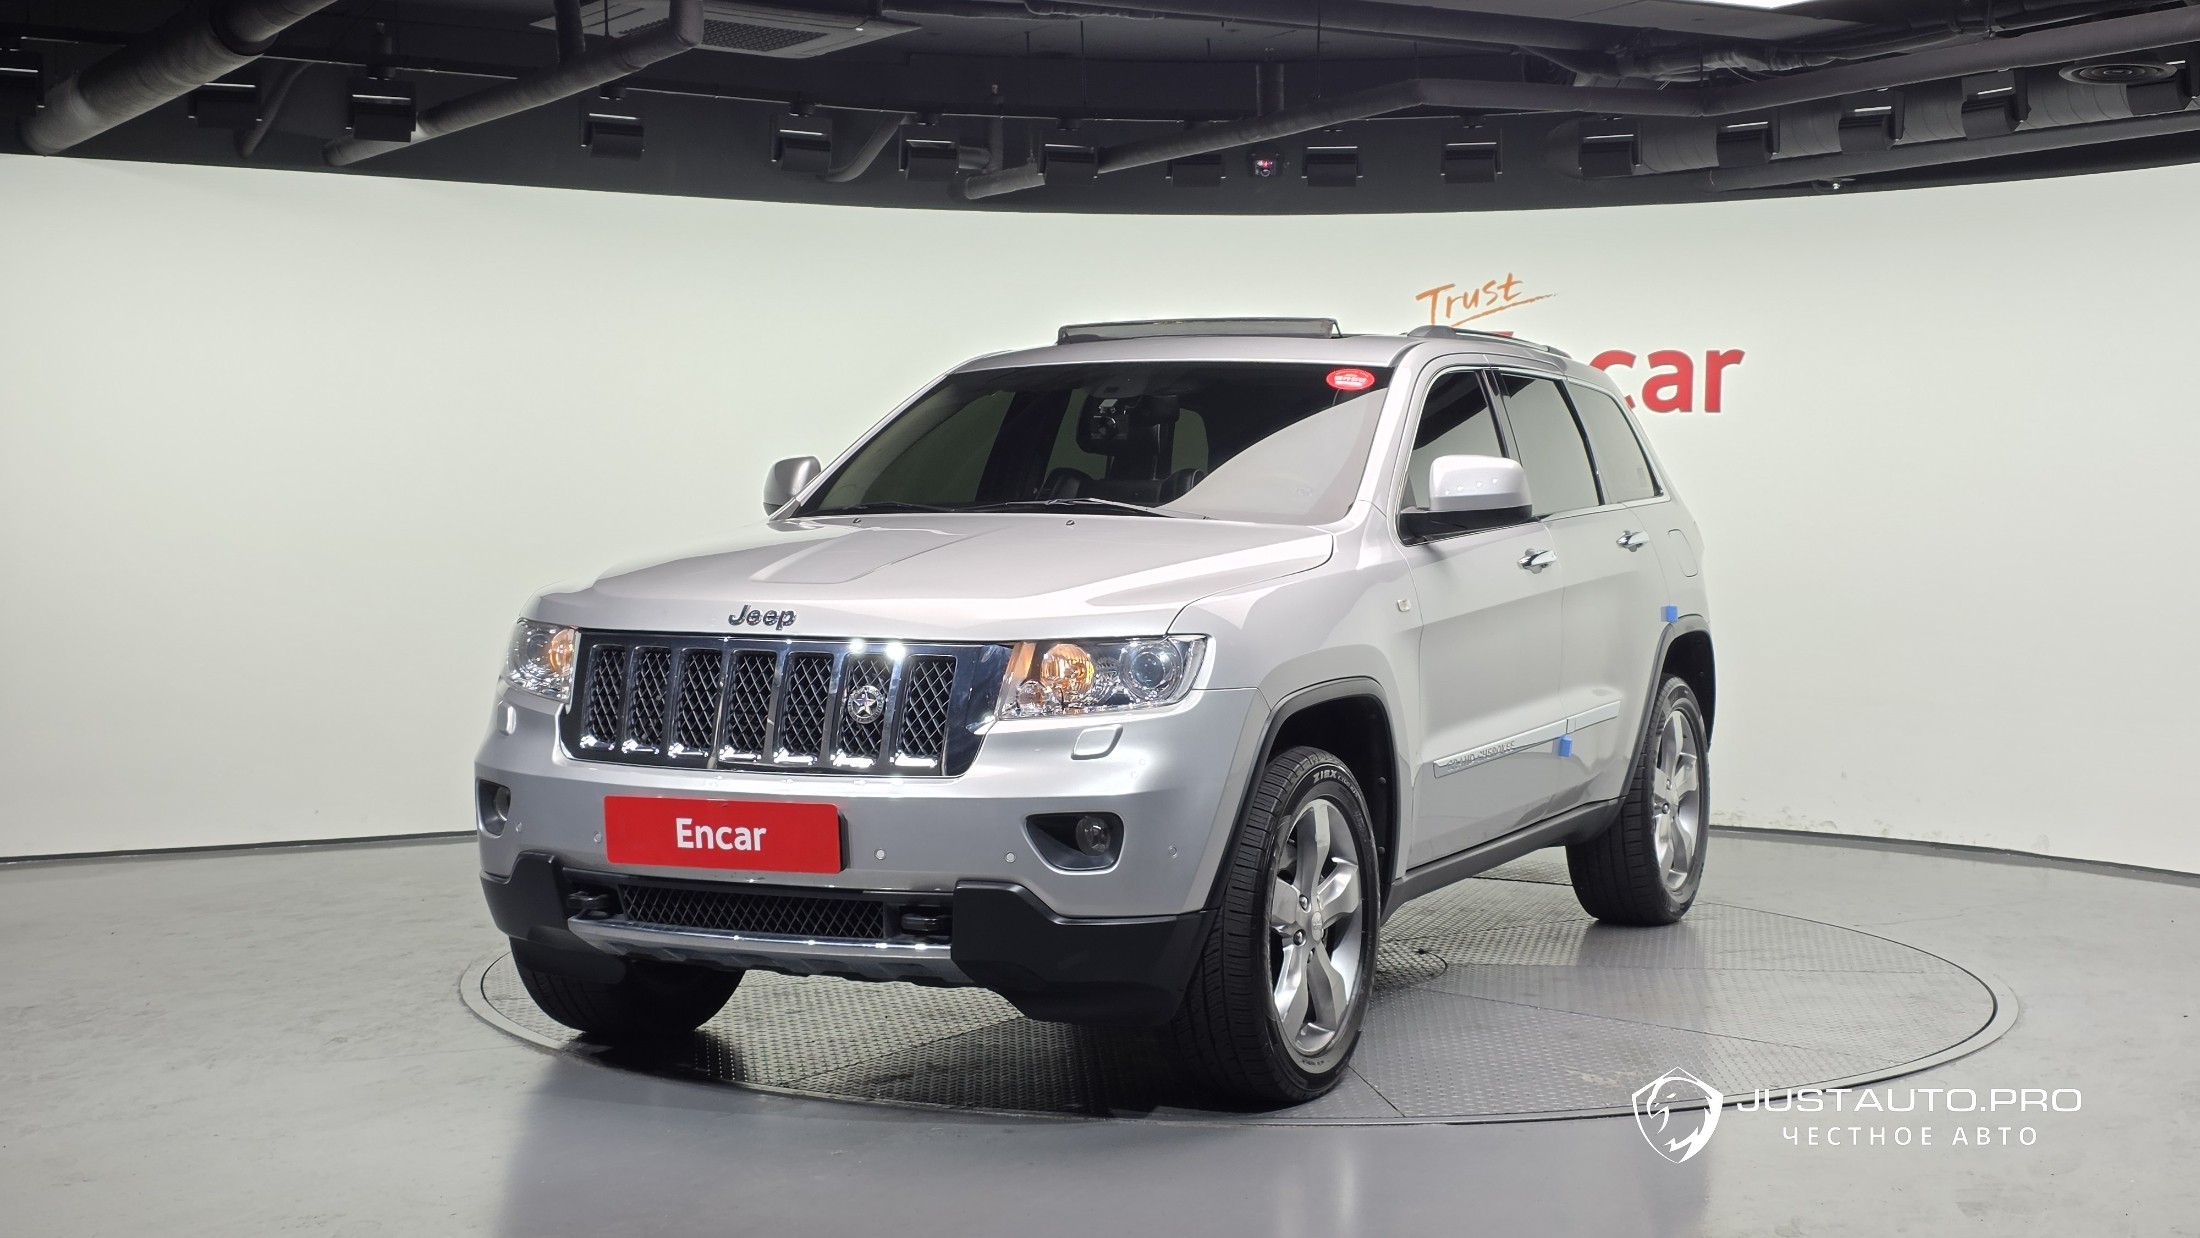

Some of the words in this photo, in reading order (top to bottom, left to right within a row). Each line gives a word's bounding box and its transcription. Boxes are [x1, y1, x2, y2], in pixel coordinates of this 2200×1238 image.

[1415, 272, 1524, 326] Trust
[728, 604, 797, 631] Jeep
[1313, 769, 1338, 784] ZIEX
[675, 817, 767, 851] Encar
